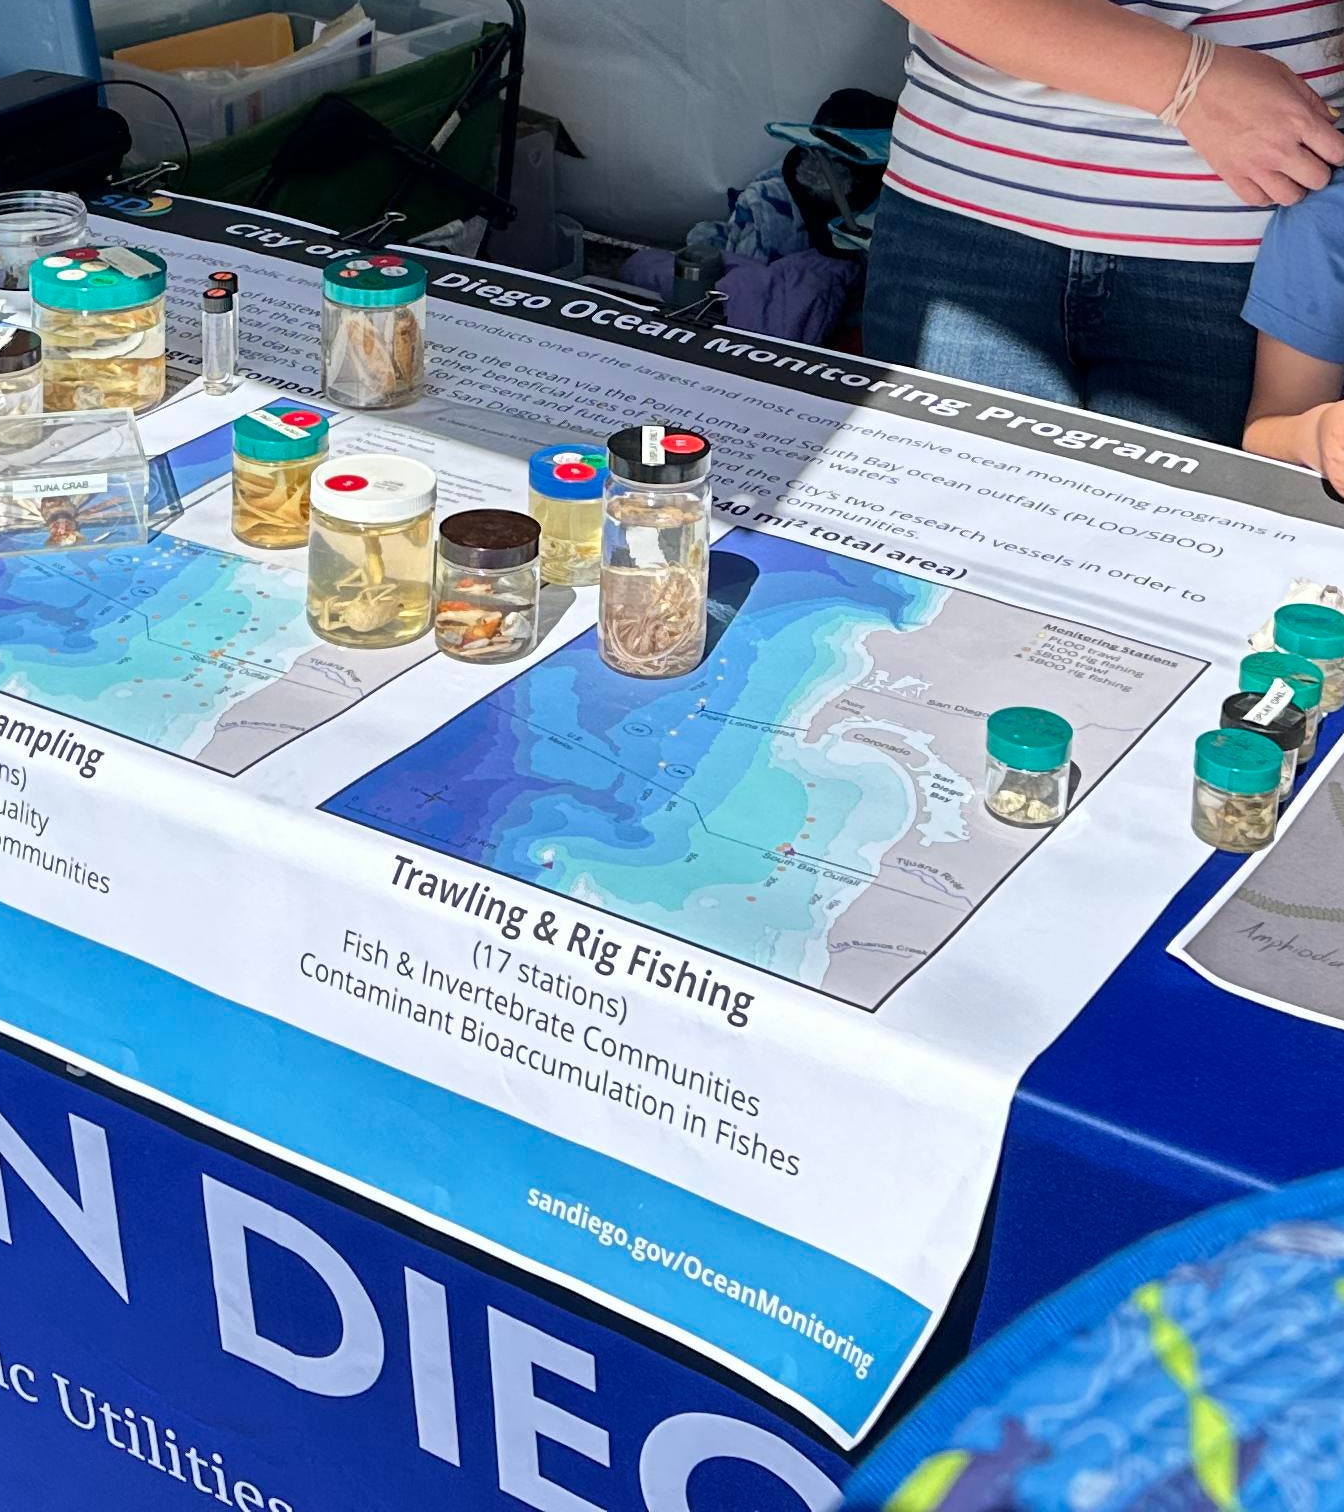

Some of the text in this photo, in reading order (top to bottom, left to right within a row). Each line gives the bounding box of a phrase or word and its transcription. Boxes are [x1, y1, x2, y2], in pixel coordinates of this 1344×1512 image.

[225, 223, 1199, 474] City of Diego Ocean Monitoring Program
[34, 480, 89, 493] TUNA CRAB
[978, 487, 1224, 558] outfalls (PLOO/SBOO)
[343, 930, 760, 1118] Fish & Invertebrate Communities
[390, 855, 755, 1028] Trawling & Rig Fishing
[471, 939, 628, 1026] (17 stations)
[300, 953, 800, 1176] Contaminant Bioaccumulation in Fishes
[527, 1187, 874, 1381] sandiego.gov/OceanMonitoring
